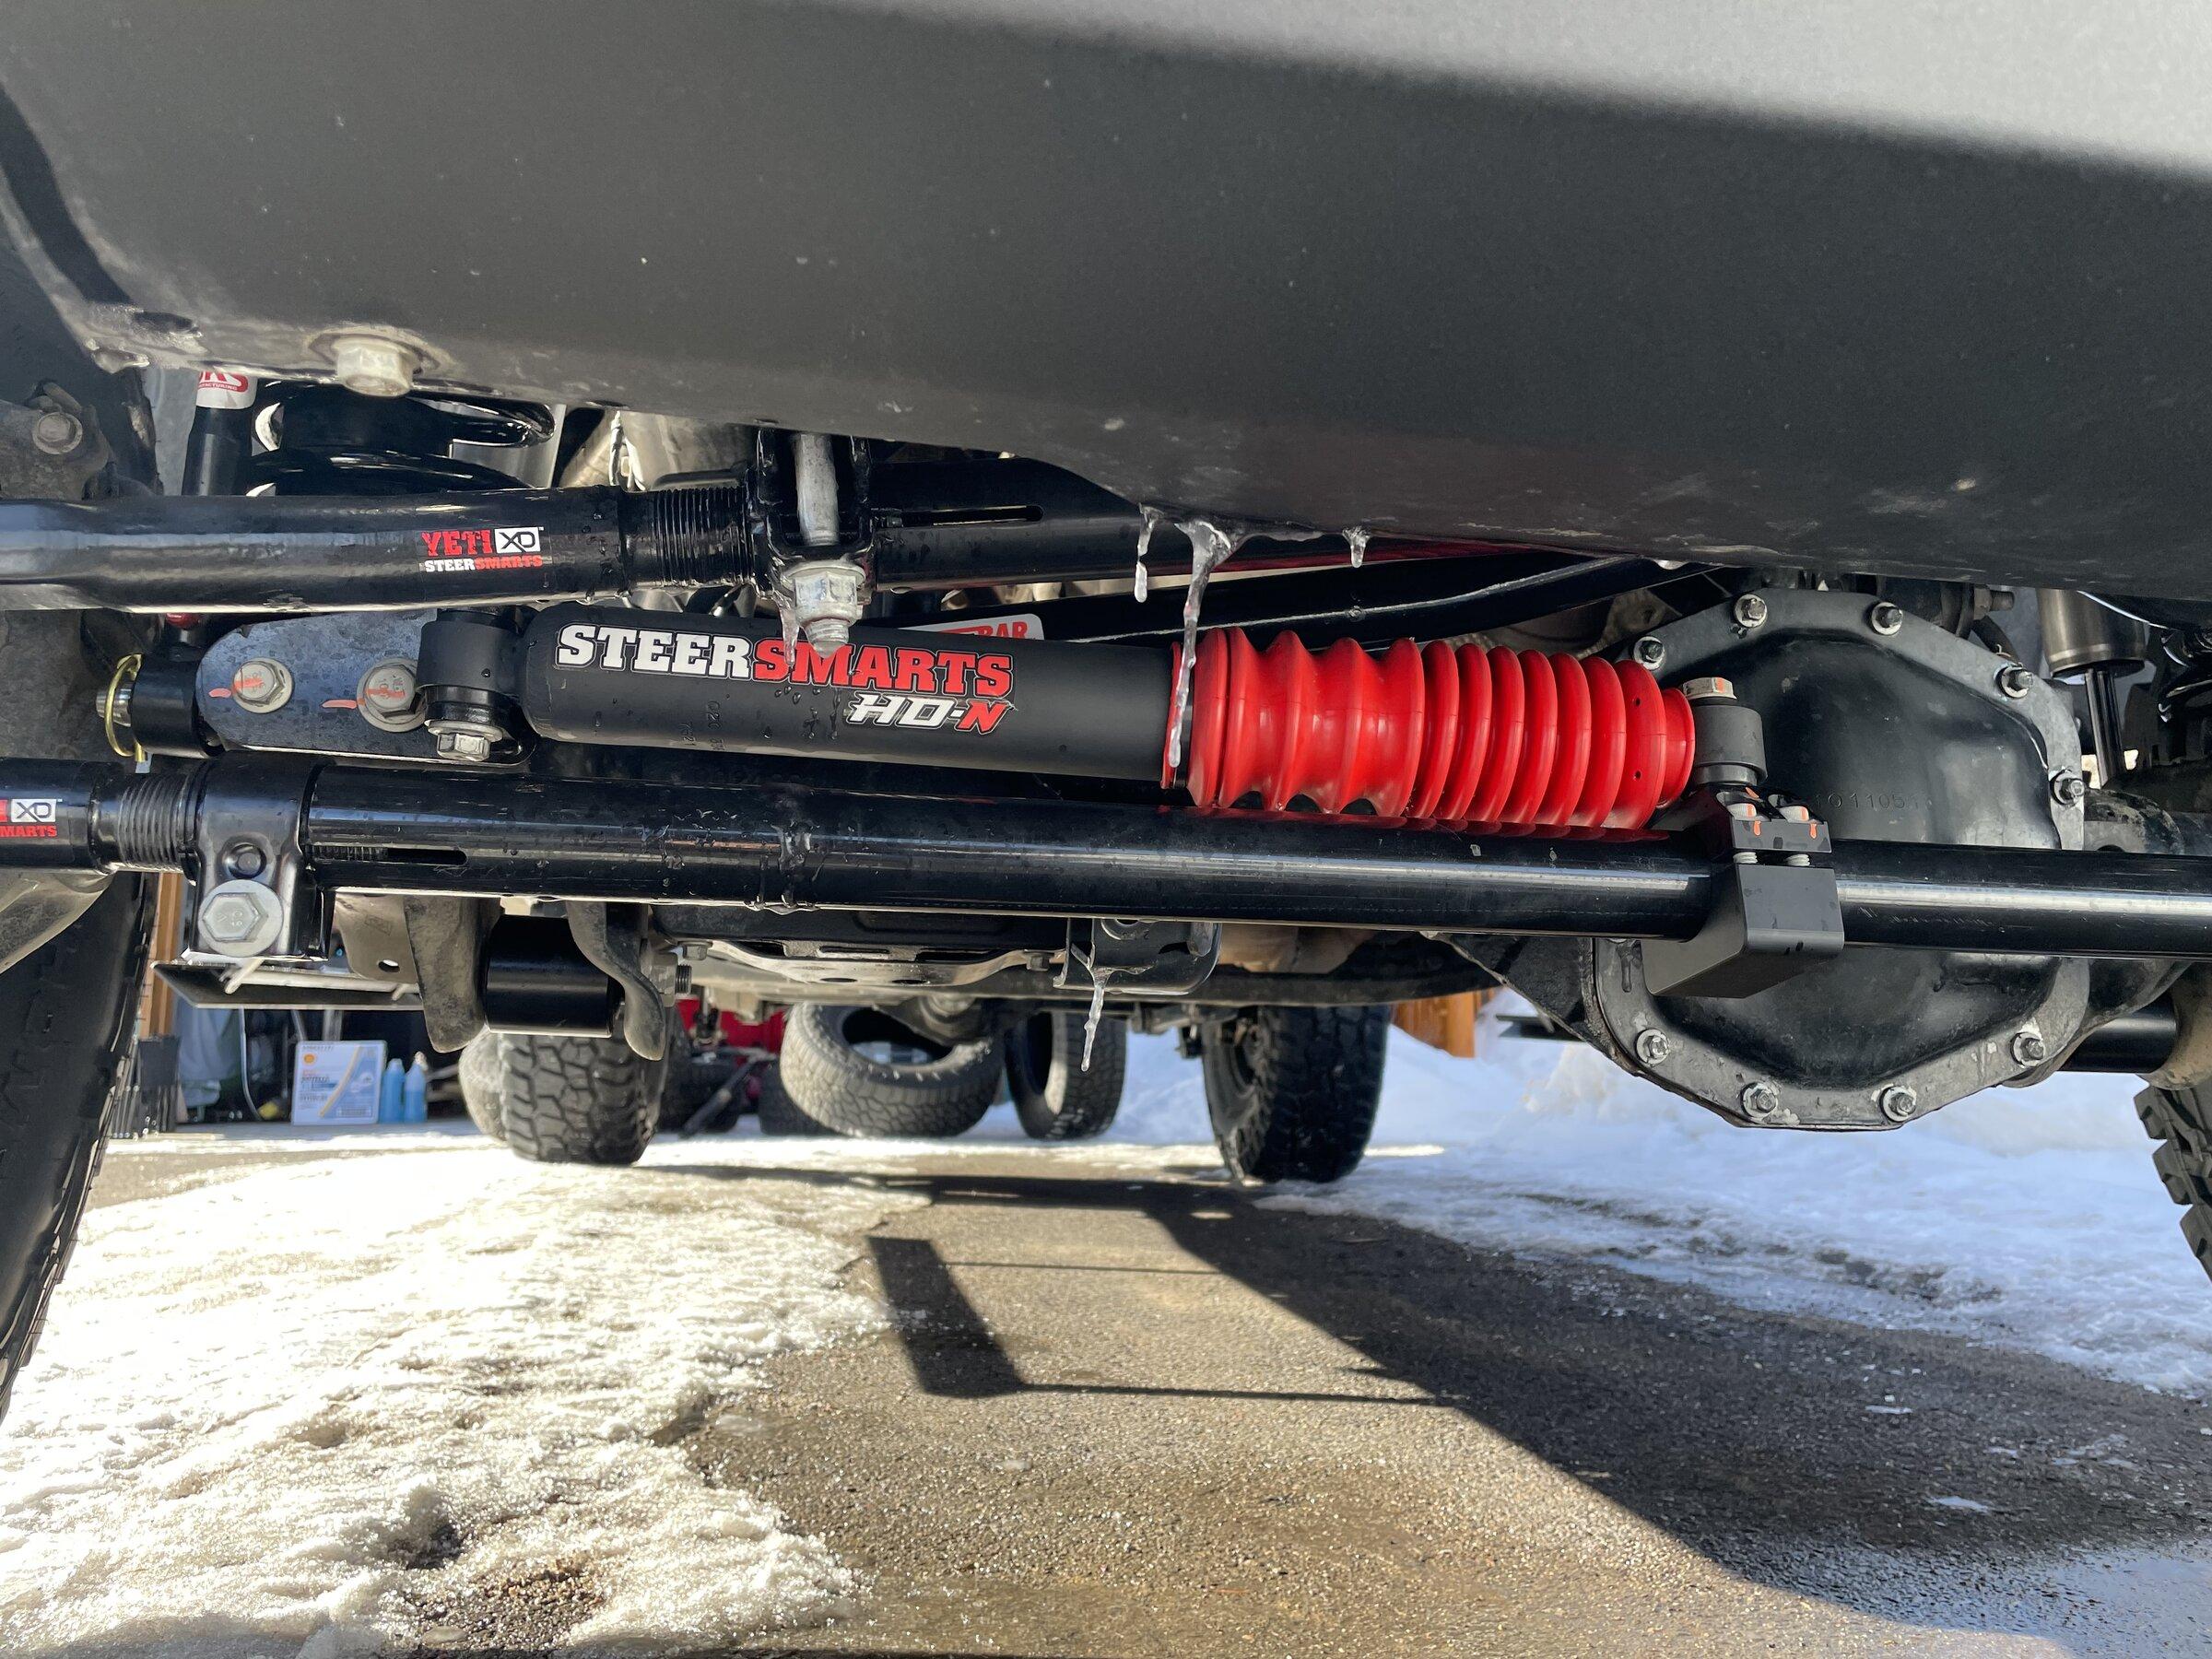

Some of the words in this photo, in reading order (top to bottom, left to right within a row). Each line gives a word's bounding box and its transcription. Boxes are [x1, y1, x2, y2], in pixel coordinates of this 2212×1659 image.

[421, 529, 493, 557] YETI
[424, 555, 543, 572] STEERSMARTS
[556, 623, 1013, 698] STEERSMARTS
[848, 693, 1012, 734] HD-N
